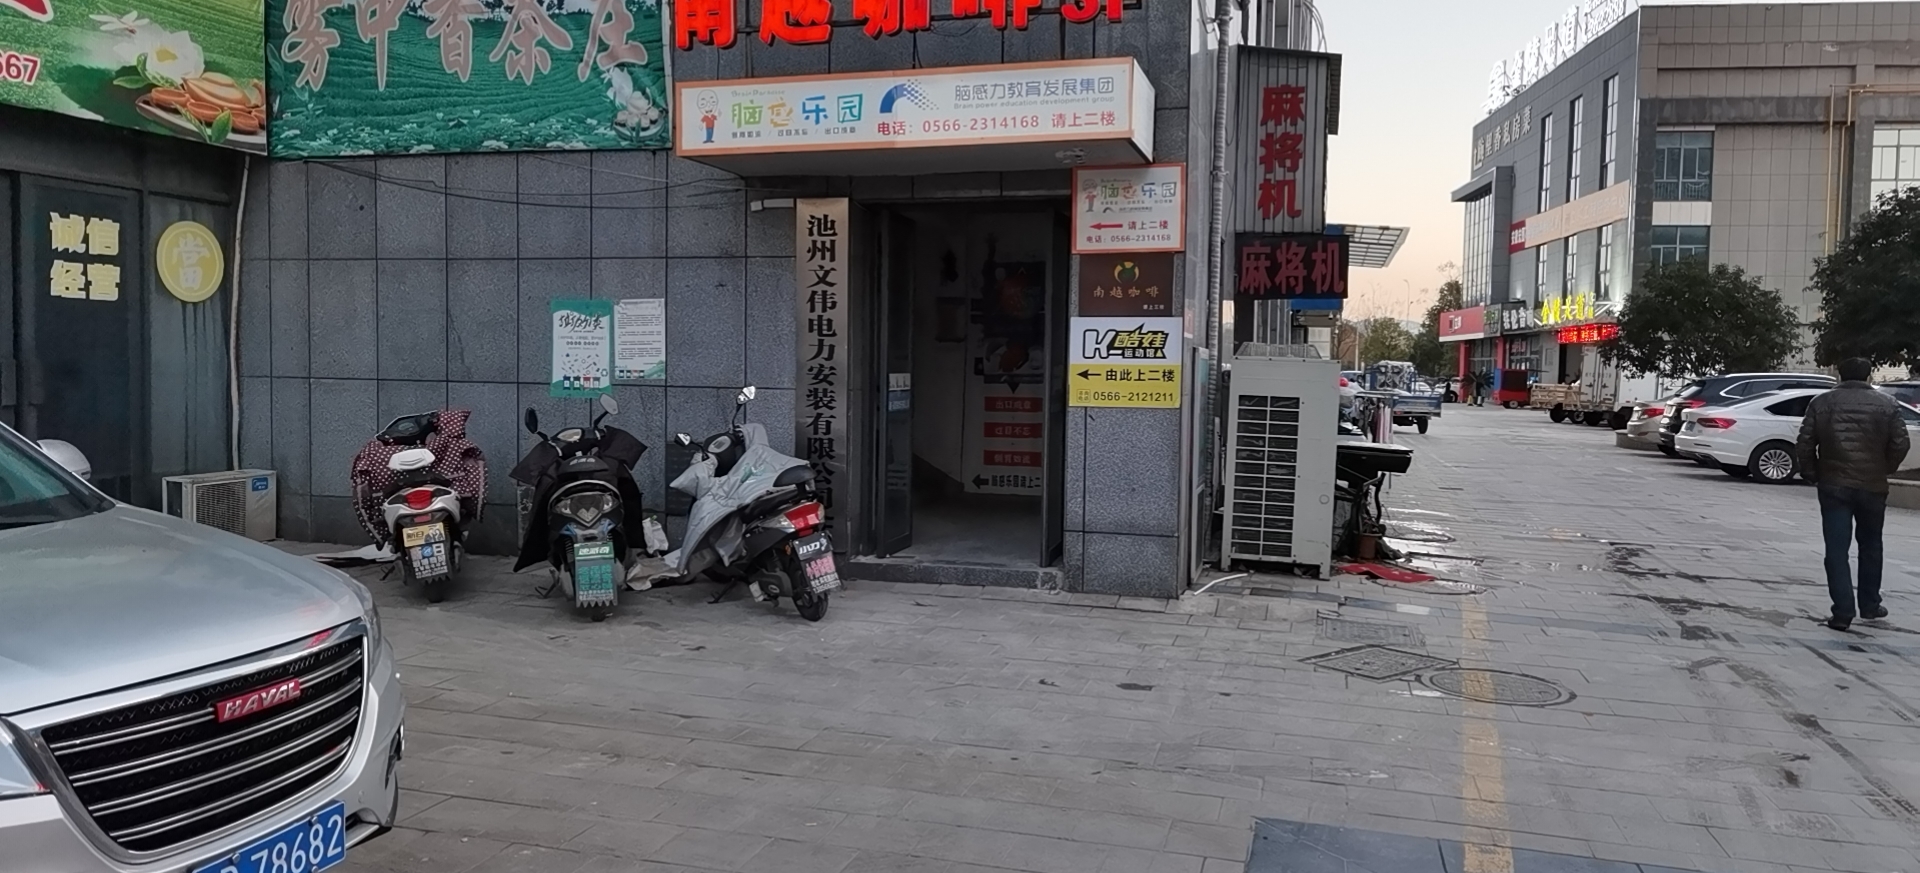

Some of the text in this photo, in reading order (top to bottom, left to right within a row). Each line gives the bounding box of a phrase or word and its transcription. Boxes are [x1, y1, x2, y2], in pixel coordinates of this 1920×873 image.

[954, 76, 1114, 102] 脑感力教育发展集团
[922, 115, 1040, 133] 0566-2314168
[1051, 110, 1117, 128] 请上二楼
[1257, 84, 1307, 219] 麻将机
[50, 212, 120, 256] 诚信
[1110, 234, 1172, 243] 0566-2314168
[1127, 220, 1169, 231] 请上二楼
[50, 259, 121, 301] 经营
[1239, 240, 1346, 296] 麻将机
[1093, 286, 1160, 299] 南越咖啡
[1105, 368, 1176, 382] 由此上二楼
[1093, 391, 1174, 403] 0566-2121211
[223, 682, 301, 720] HAVAL
[220, 813, 343, 873] 78682
